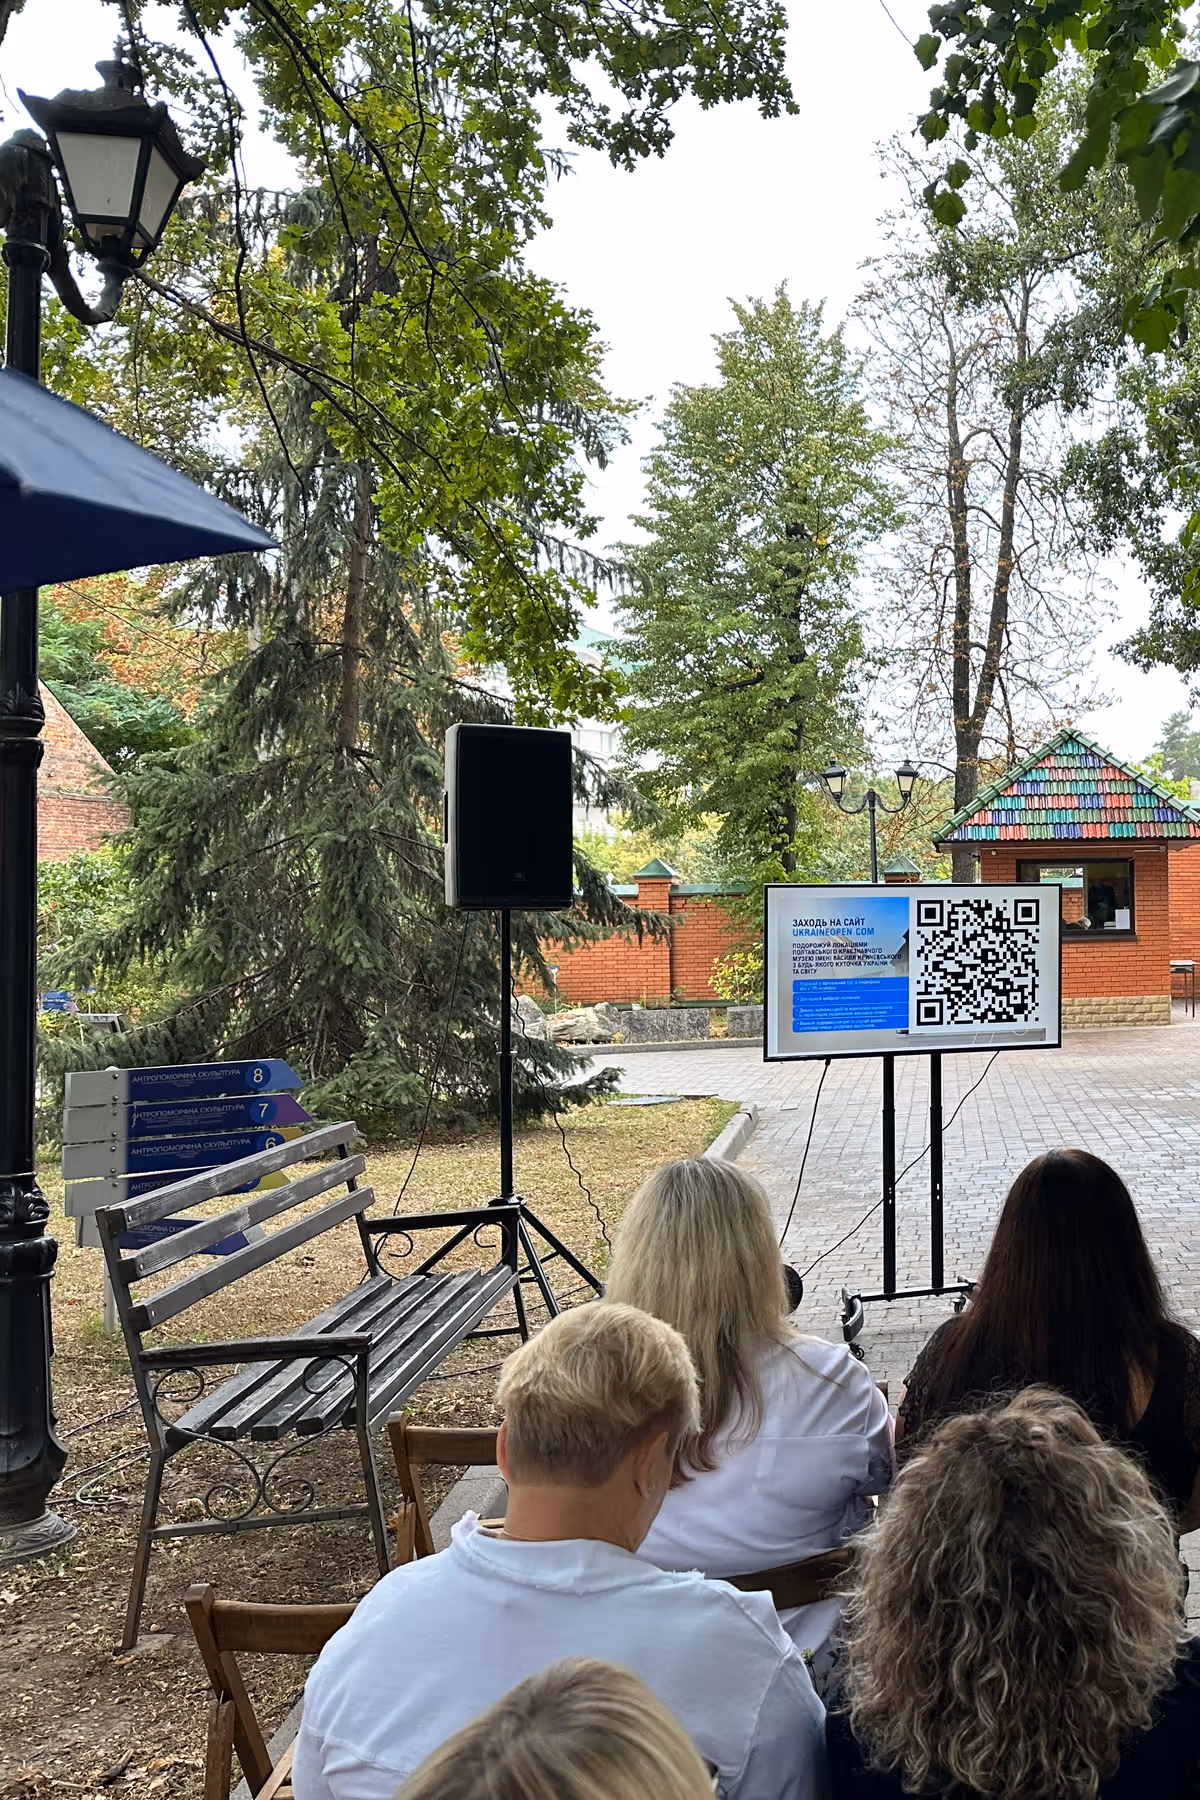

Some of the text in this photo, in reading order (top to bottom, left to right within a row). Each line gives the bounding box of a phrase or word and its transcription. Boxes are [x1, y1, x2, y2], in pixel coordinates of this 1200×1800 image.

[792, 917, 866, 928] ЗАХОДЬ НА САЙТ
[792, 942, 831, 950] ПОДОРОЖУЙ
[798, 961, 834, 969] БУДЬ-ЯКОГО
[835, 960, 862, 968] КУТОЧКА
[863, 959, 888, 967] УКРАЇНИ
[132, 1068, 263, 1083] АНТРОПОМОРФНА СКУЛЬПТУРА 8
[132, 1103, 269, 1119] АНТРОПОМОРФНА СКУЛЬПТУРА 7
[131, 1137, 276, 1155] АНТРОПОМОРФНА СКУЛЬПТУРА 6
